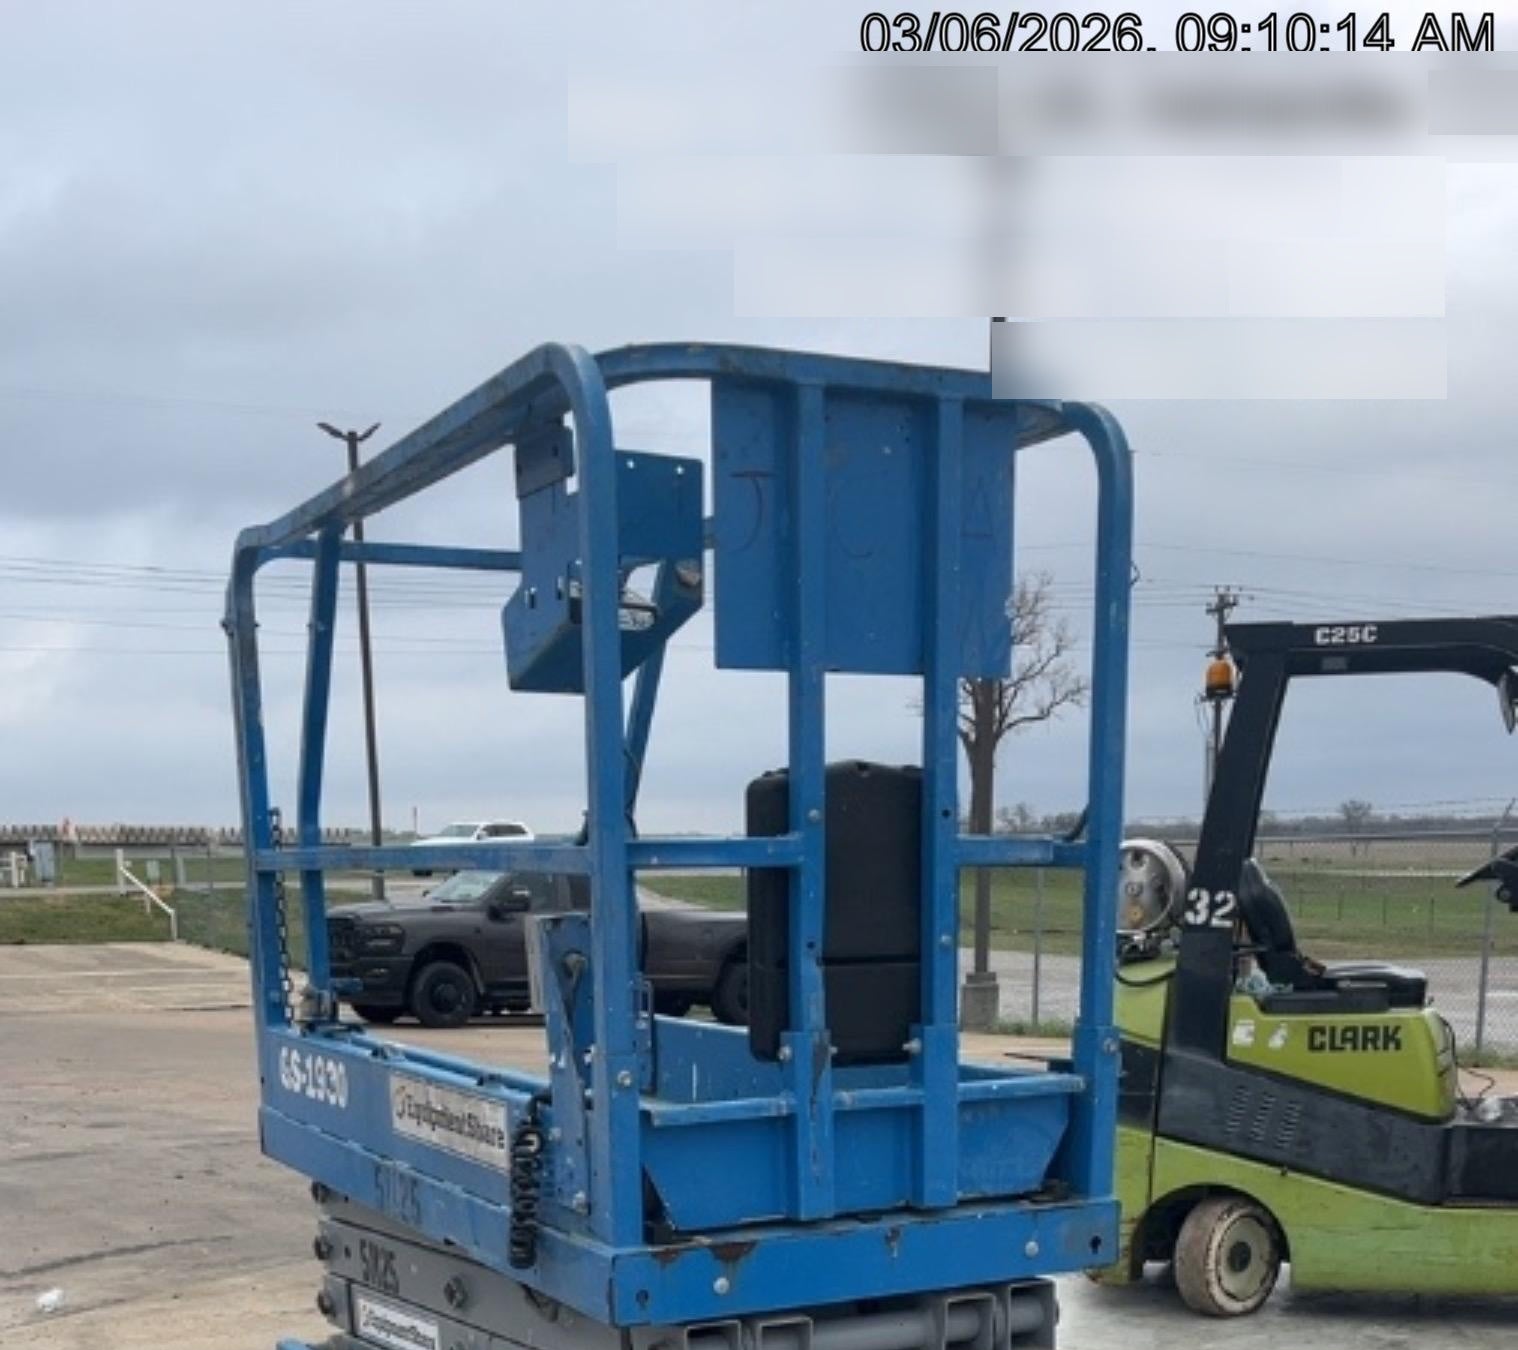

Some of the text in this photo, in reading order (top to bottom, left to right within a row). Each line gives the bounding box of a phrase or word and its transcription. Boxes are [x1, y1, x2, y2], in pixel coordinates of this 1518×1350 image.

[1315, 624, 1378, 647] C25C
[1184, 887, 1237, 928] 32
[1307, 1024, 1403, 1052] CLARK
[280, 1046, 349, 1109] GS-1930
[406, 1094, 505, 1150] EquipmentShare
